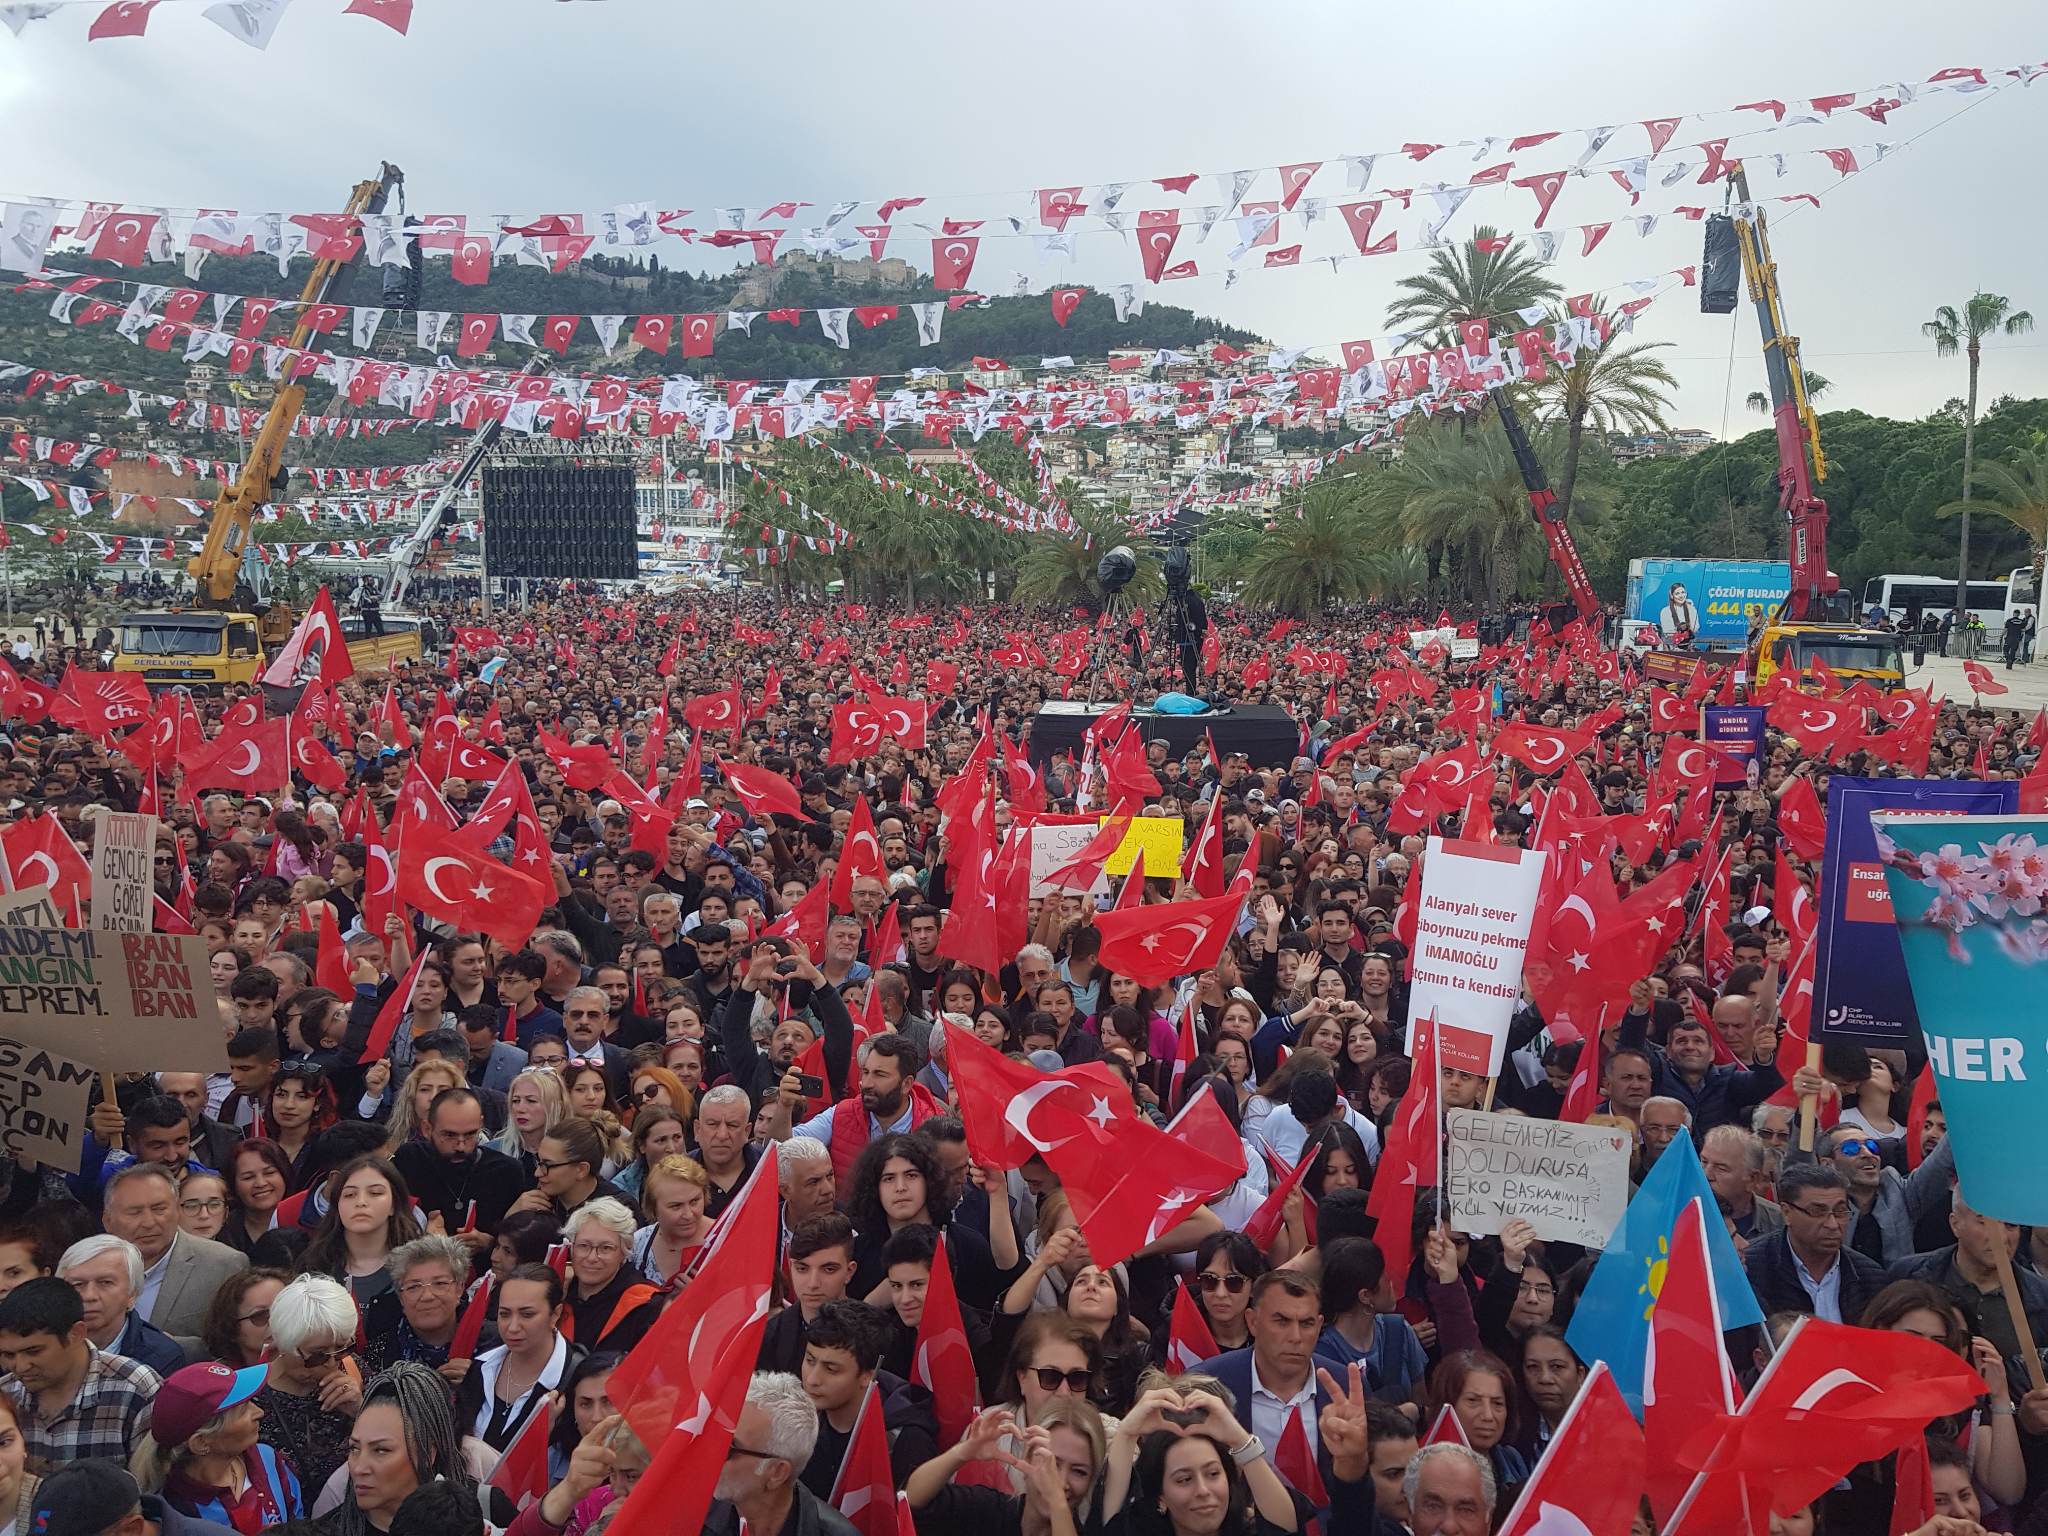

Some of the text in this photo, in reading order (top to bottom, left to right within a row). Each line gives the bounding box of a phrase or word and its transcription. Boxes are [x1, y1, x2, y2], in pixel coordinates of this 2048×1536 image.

[1708, 586, 1745, 599] ÇÖZÜM
[1707, 602, 1740, 615] 444
[113, 882, 145, 918] GÖREV
[1425, 895, 1517, 922] Alanyalı sever
[1417, 919, 1479, 941] iboynuzu
[1425, 942, 1498, 970] İMAMOĞLU
[127, 960, 193, 990] IBAN
[1452, 976, 1465, 989] ta
[1469, 978, 1517, 998] kendisi
[132, 988, 198, 1019] IBAN
[1922, 1029, 2027, 1082] HER
[1451, 1176, 1491, 1195] EKO
[1452, 1198, 1487, 1216] KÜL
